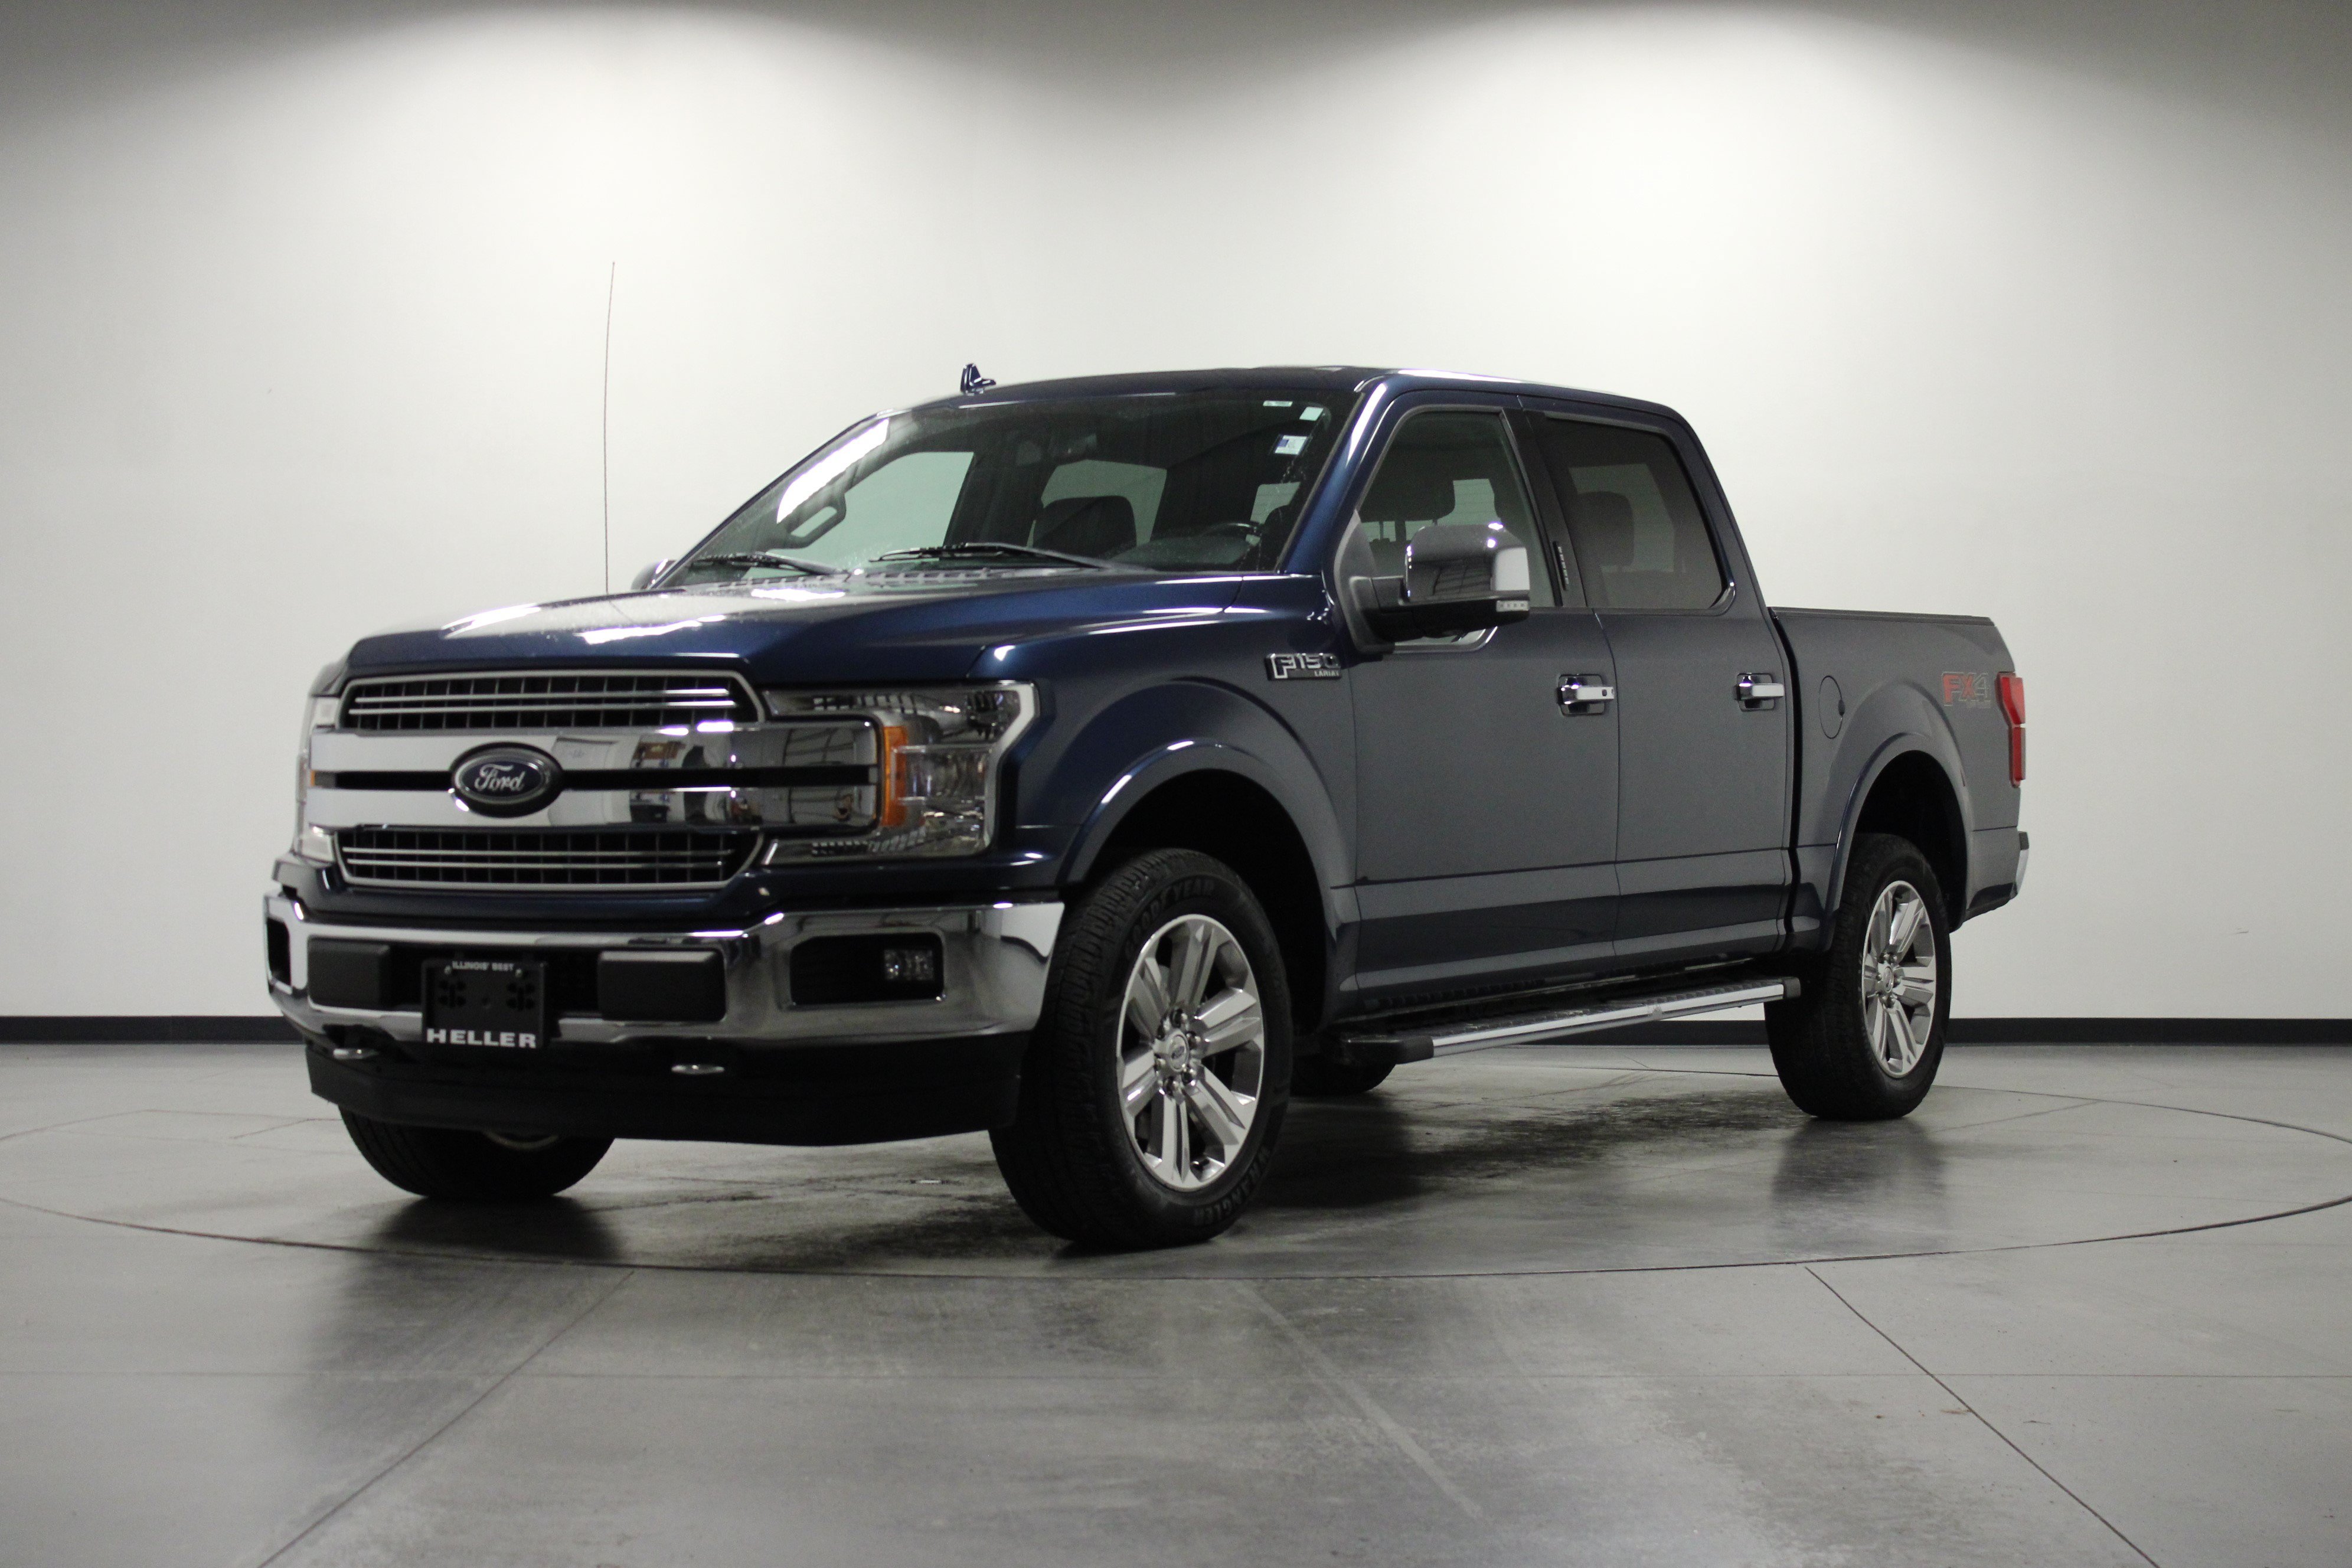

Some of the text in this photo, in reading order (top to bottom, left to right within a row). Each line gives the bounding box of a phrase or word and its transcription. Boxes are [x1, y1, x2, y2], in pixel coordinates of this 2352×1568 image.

[1941, 671, 1992, 707] FX4
[473, 763, 525, 792] Ford
[426, 1027, 537, 1049] HELLER
